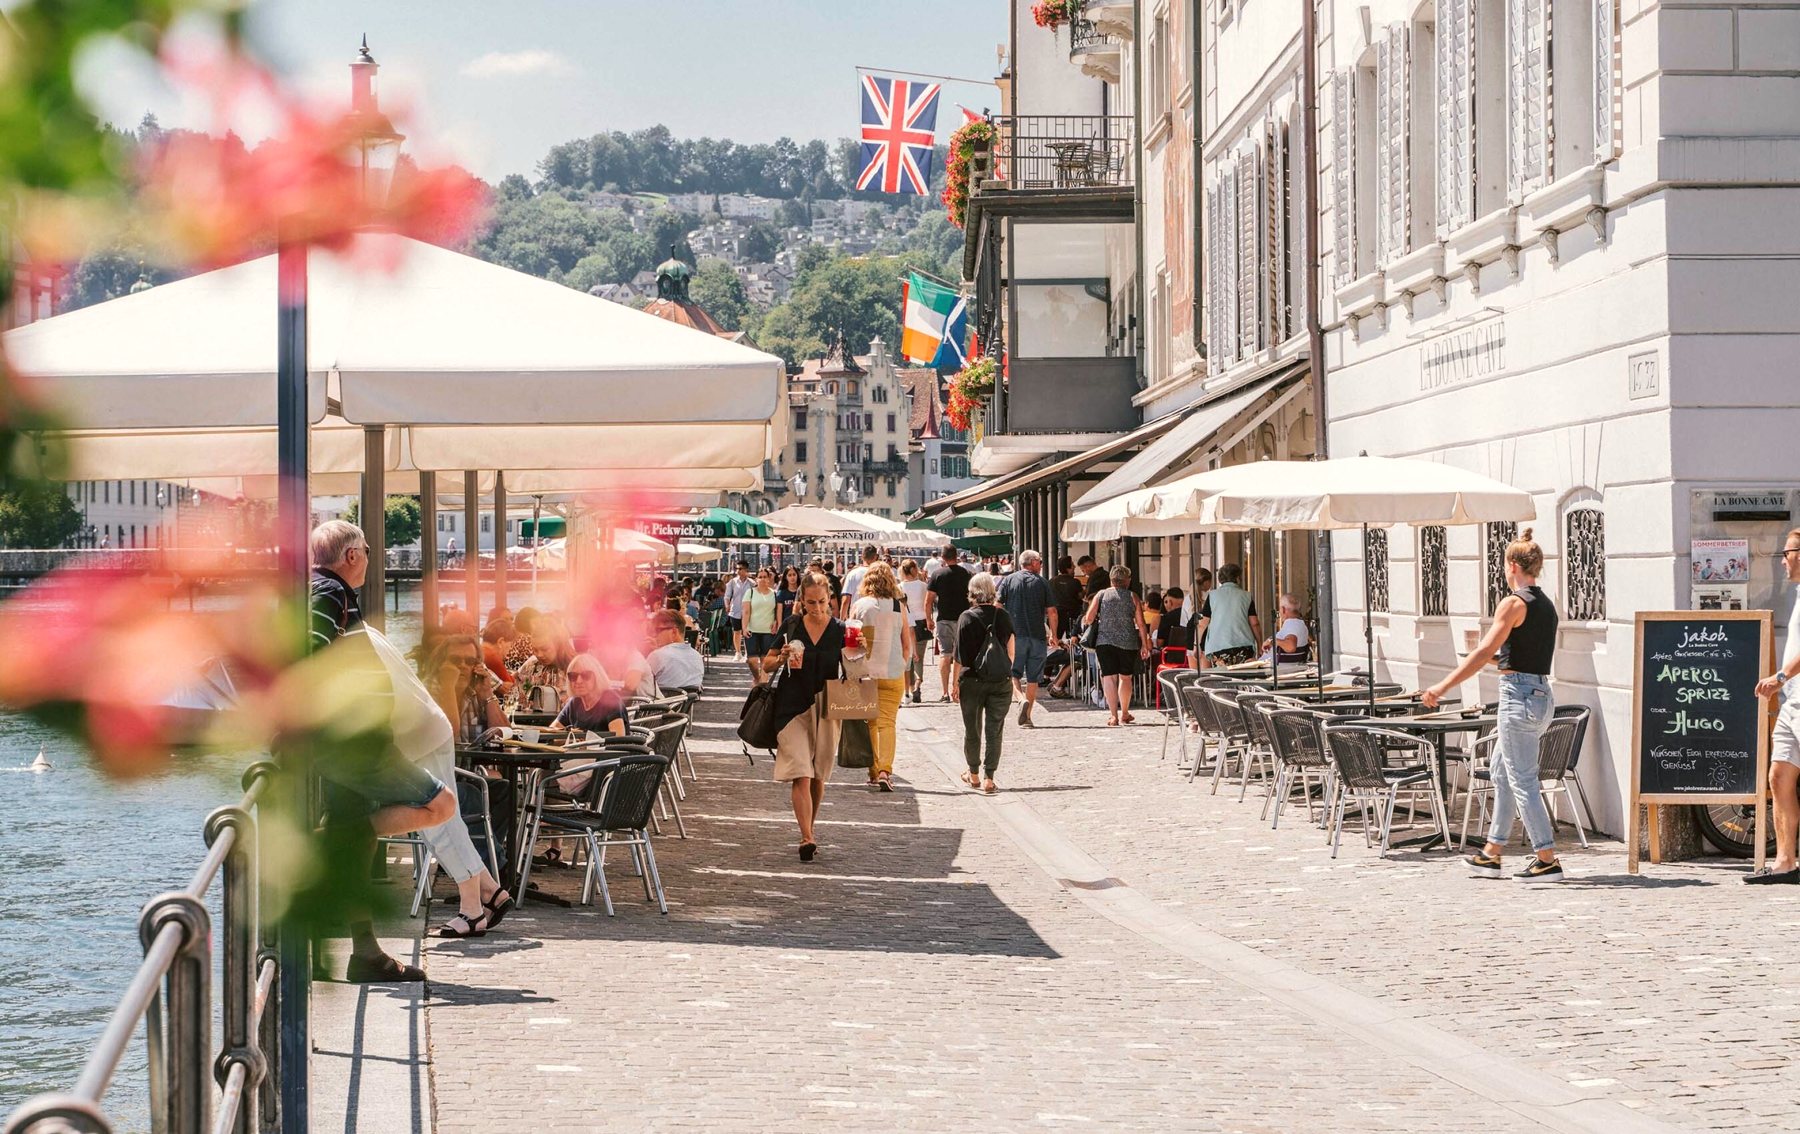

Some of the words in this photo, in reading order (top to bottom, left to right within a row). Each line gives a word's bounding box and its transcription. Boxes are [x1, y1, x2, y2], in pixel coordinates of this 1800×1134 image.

[1419, 347, 1433, 391] LA
[1434, 331, 1472, 387] BONNE
[1475, 321, 1505, 376] CAVE
[1714, 497, 1726, 506] LA
[1728, 497, 1760, 506] BONNE
[1762, 497, 1785, 506] CAVE
[652, 522, 696, 536] Pickwick
[1656, 664, 1725, 685] APEROL
[1675, 687, 1731, 704] SPRIZZ
[1663, 710, 1725, 736] HUGO
